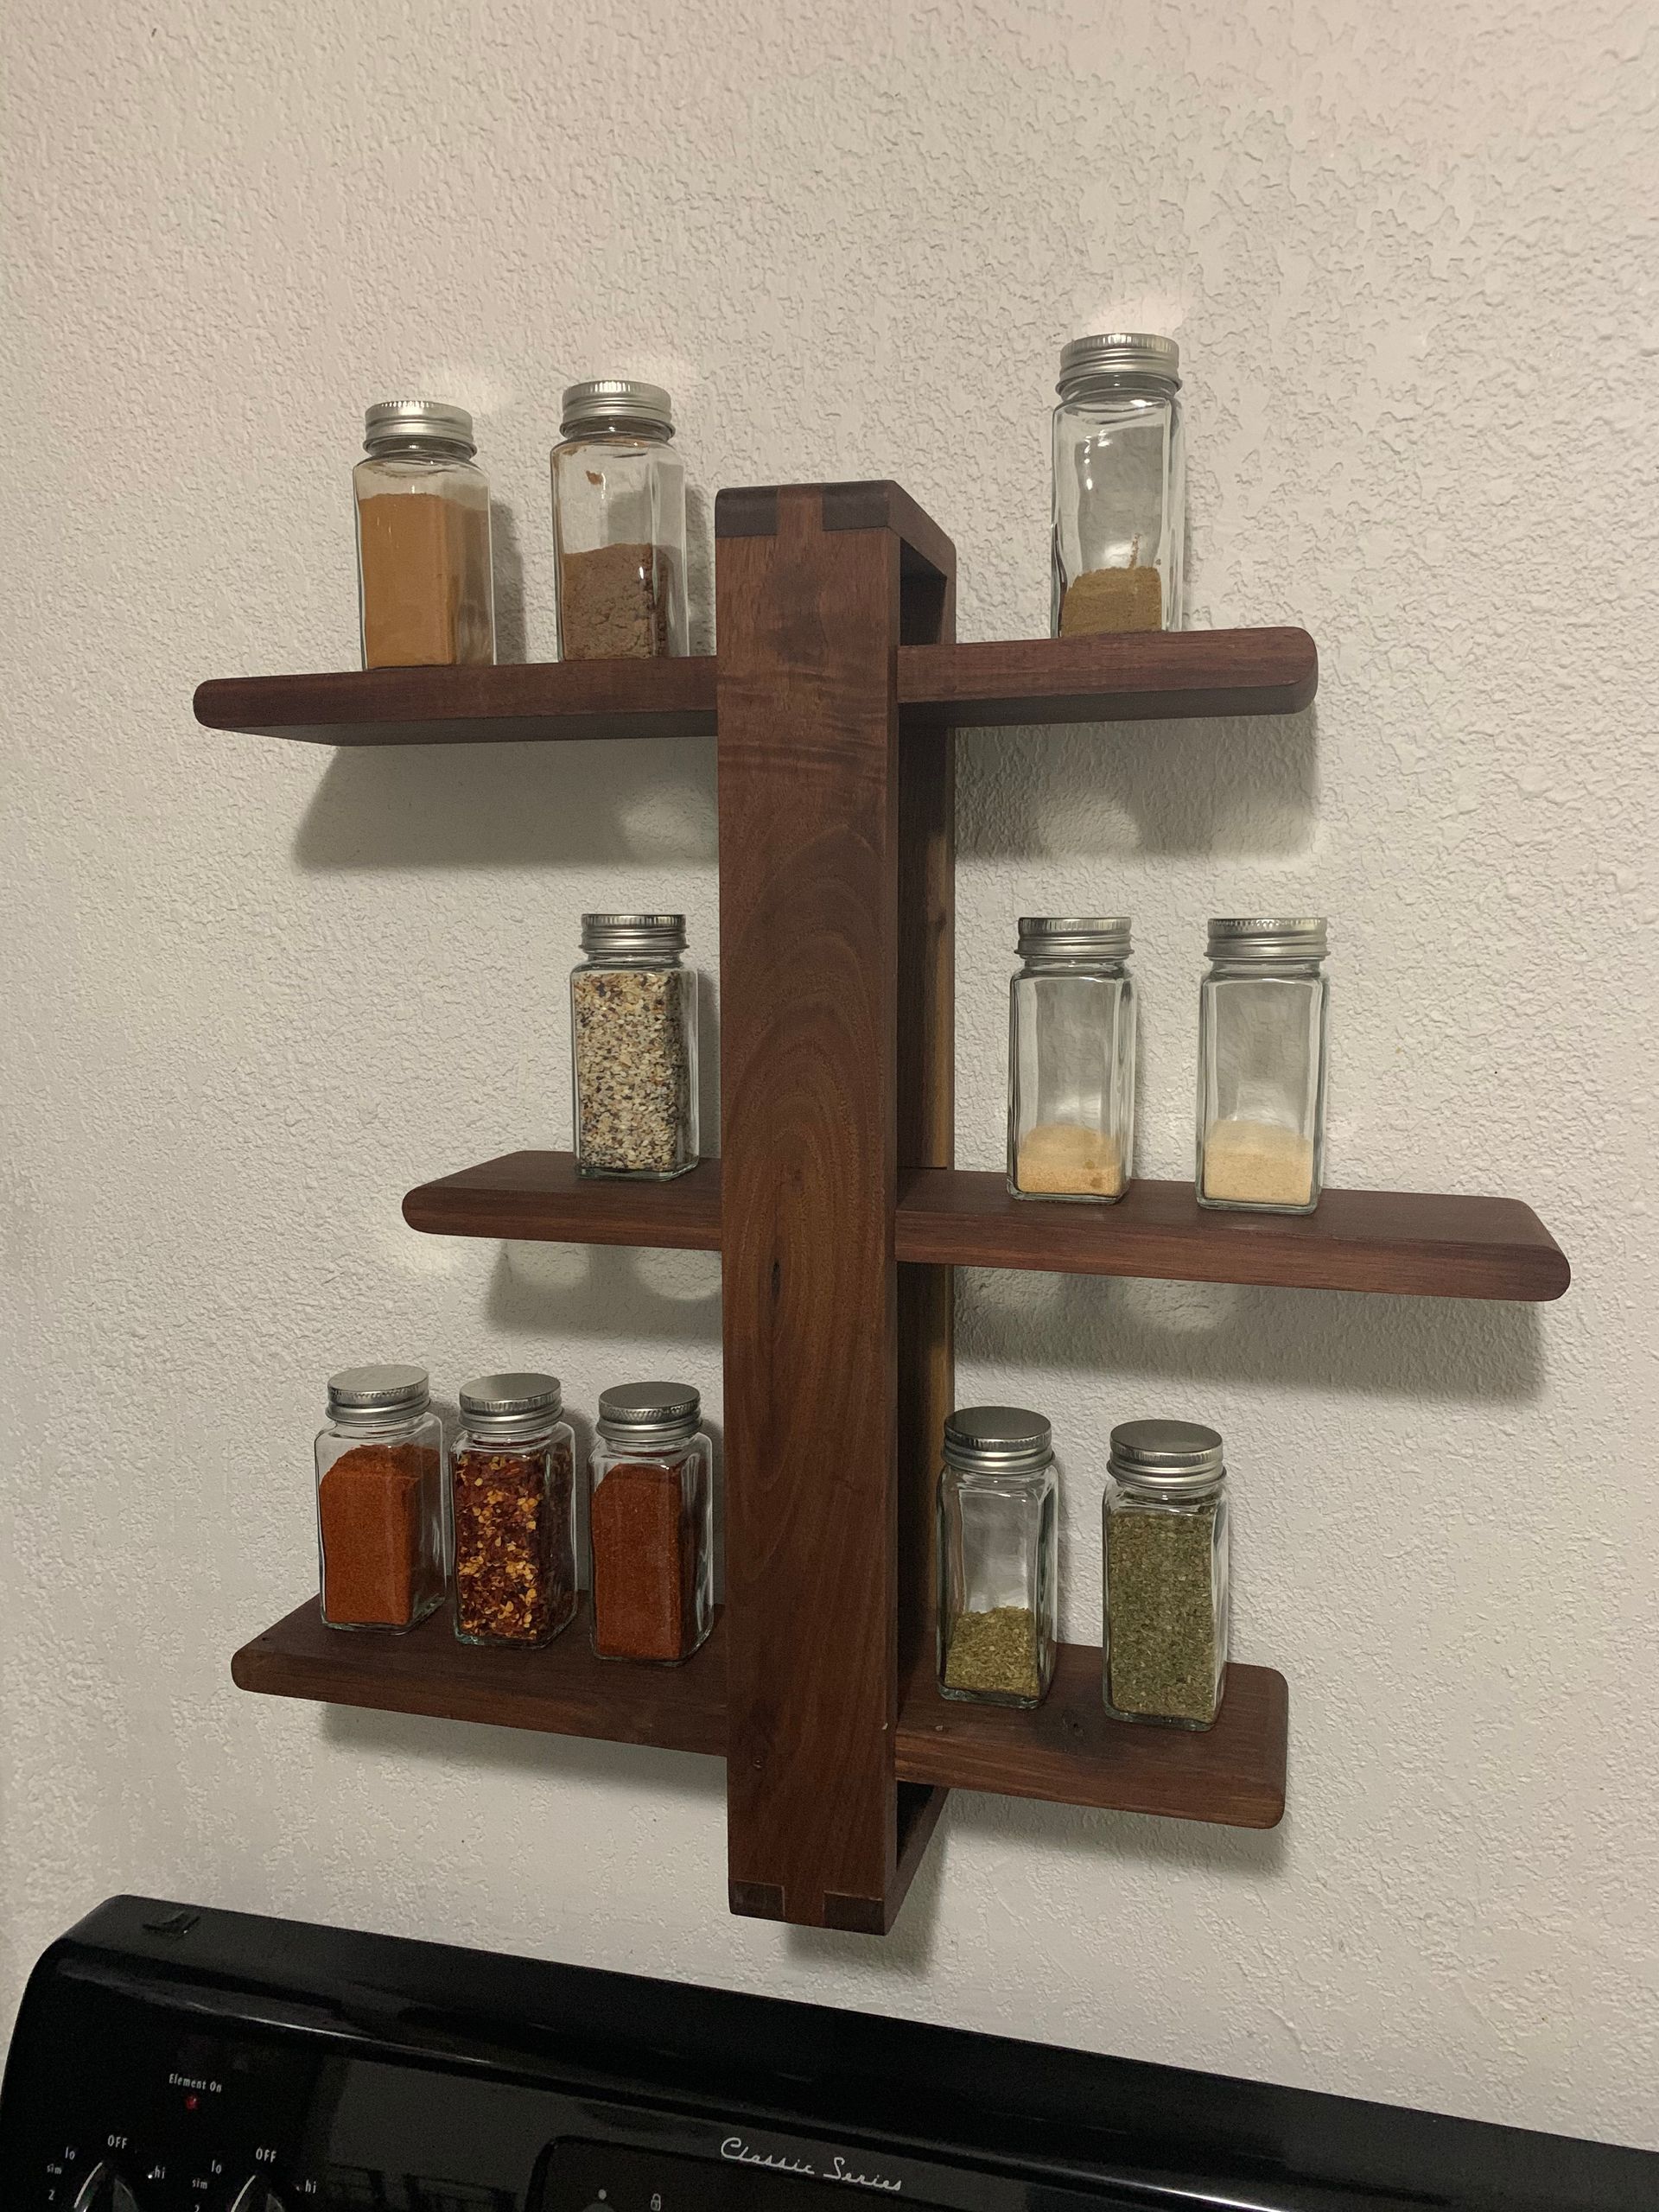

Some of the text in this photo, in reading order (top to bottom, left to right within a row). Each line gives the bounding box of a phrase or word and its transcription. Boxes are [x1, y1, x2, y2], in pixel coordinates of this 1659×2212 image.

[168, 2073, 222, 2094] Element On
[107, 2134, 128, 2150] OFF
[65, 2145, 76, 2160] lo
[255, 2148, 277, 2163] OFF
[47, 2163, 62, 2175] sim
[211, 2159, 222, 2174] lo
[721, 2137, 902, 2191] Classic Series
[154, 2165, 166, 2180] hi
[192, 2177, 208, 2190] sim
[304, 2179, 317, 2194] hi
[48, 2189, 55, 2201] 2
